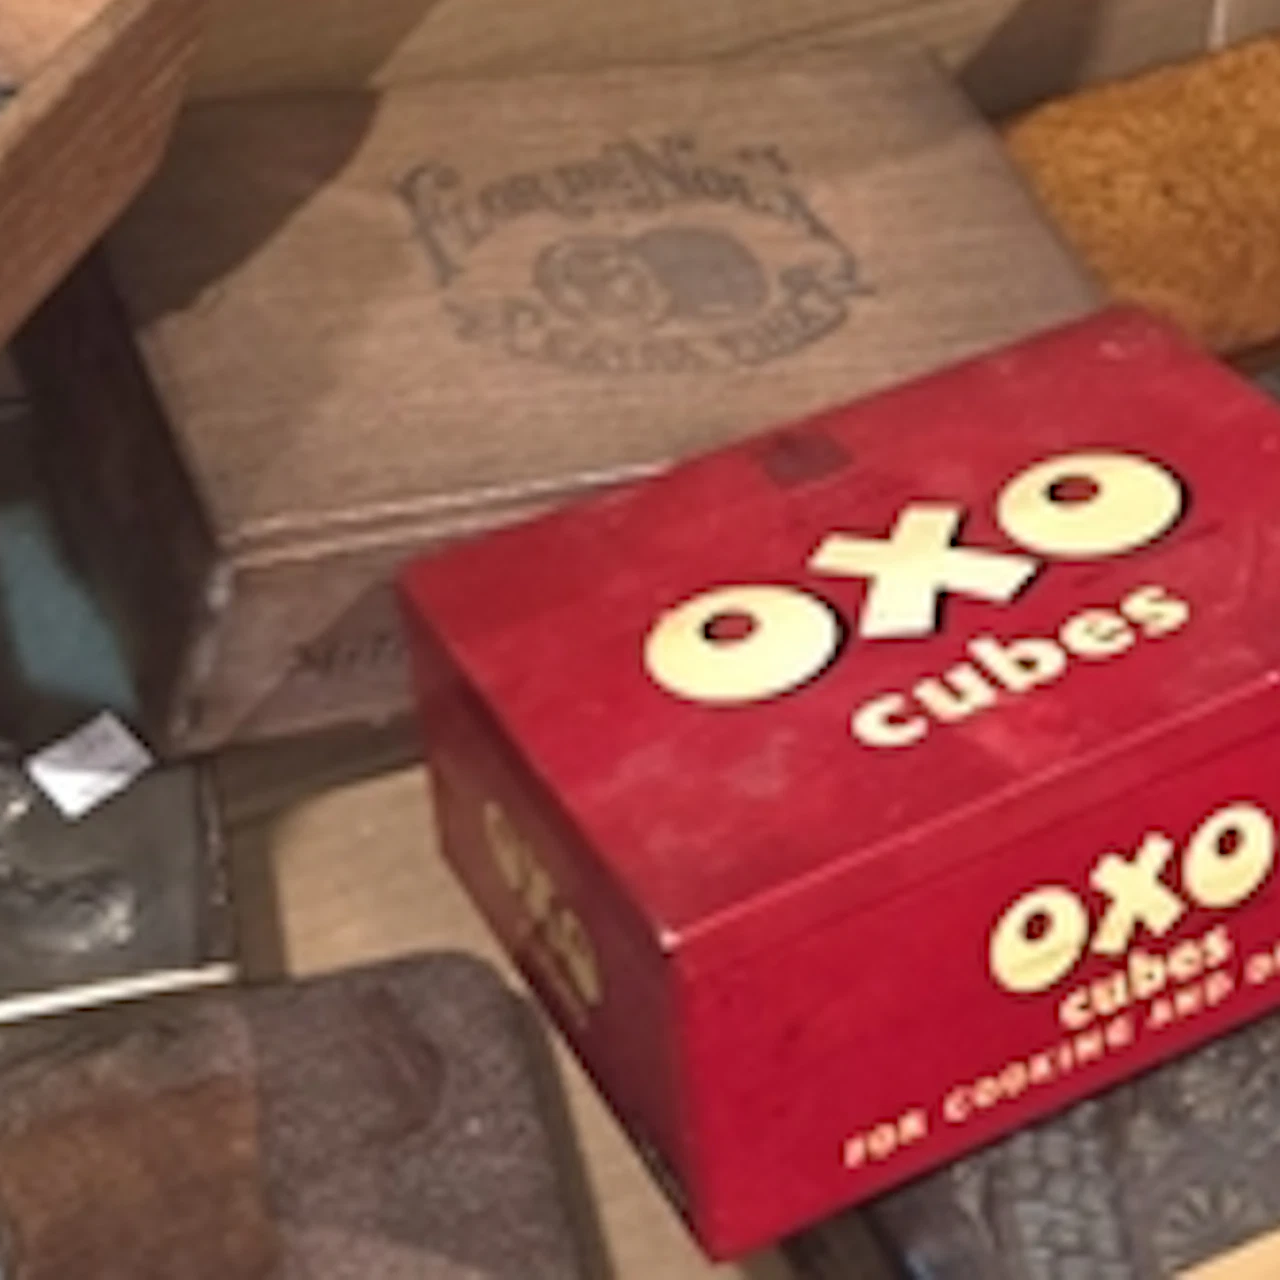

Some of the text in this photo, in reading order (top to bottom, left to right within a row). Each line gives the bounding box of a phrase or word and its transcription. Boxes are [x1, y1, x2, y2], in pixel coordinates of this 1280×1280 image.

[643, 451, 1191, 704] OXO
[849, 584, 1191, 747] cubes
[988, 801, 1277, 993] OXO
[1058, 925, 1233, 1029] cubes
[843, 1109, 928, 1169] FOR
[942, 1018, 1133, 1124] COOKING
[1147, 970, 1235, 1028] AND
